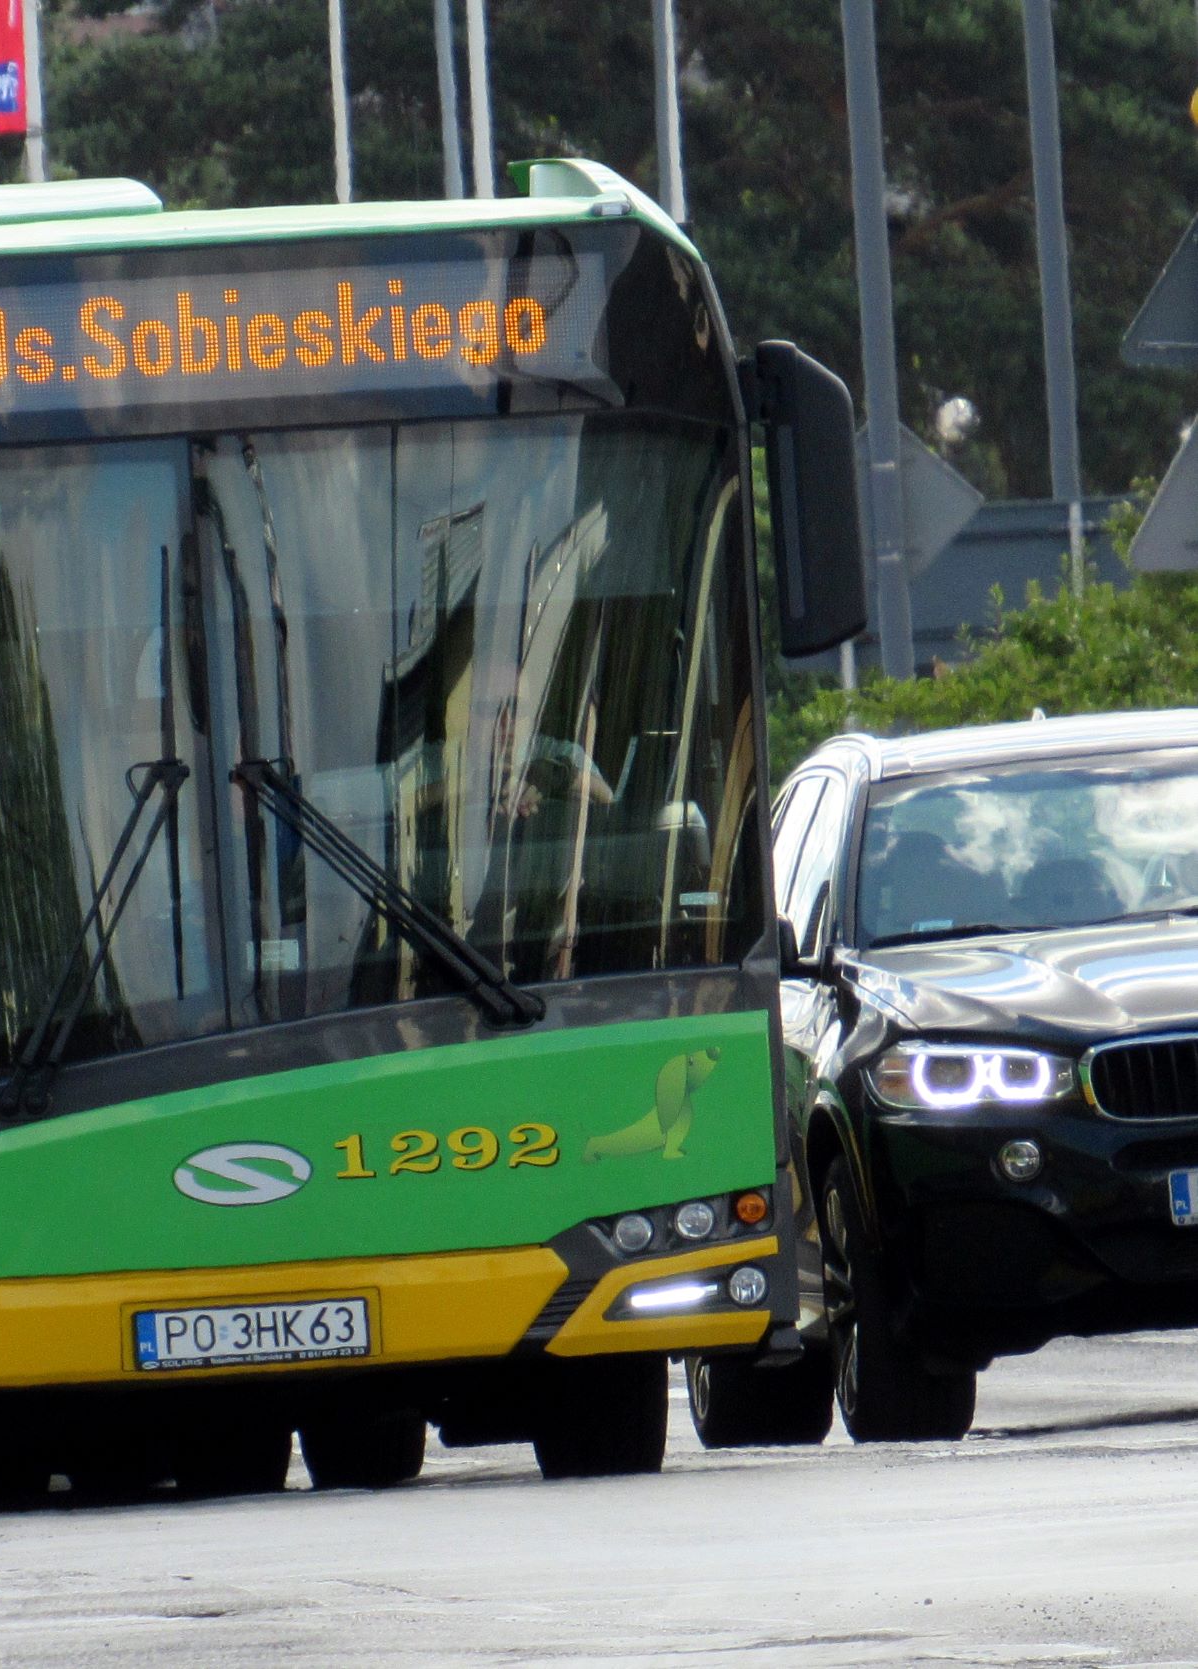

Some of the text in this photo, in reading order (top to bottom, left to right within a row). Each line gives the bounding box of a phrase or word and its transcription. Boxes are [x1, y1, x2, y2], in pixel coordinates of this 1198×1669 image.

[334, 1122, 560, 1179] 1292
[1175, 1200, 1189, 1210] PL
[164, 1306, 355, 1355] PO 3HK63
[140, 1342, 154, 1353] PL
[162, 1358, 204, 1368] SOLARIS
